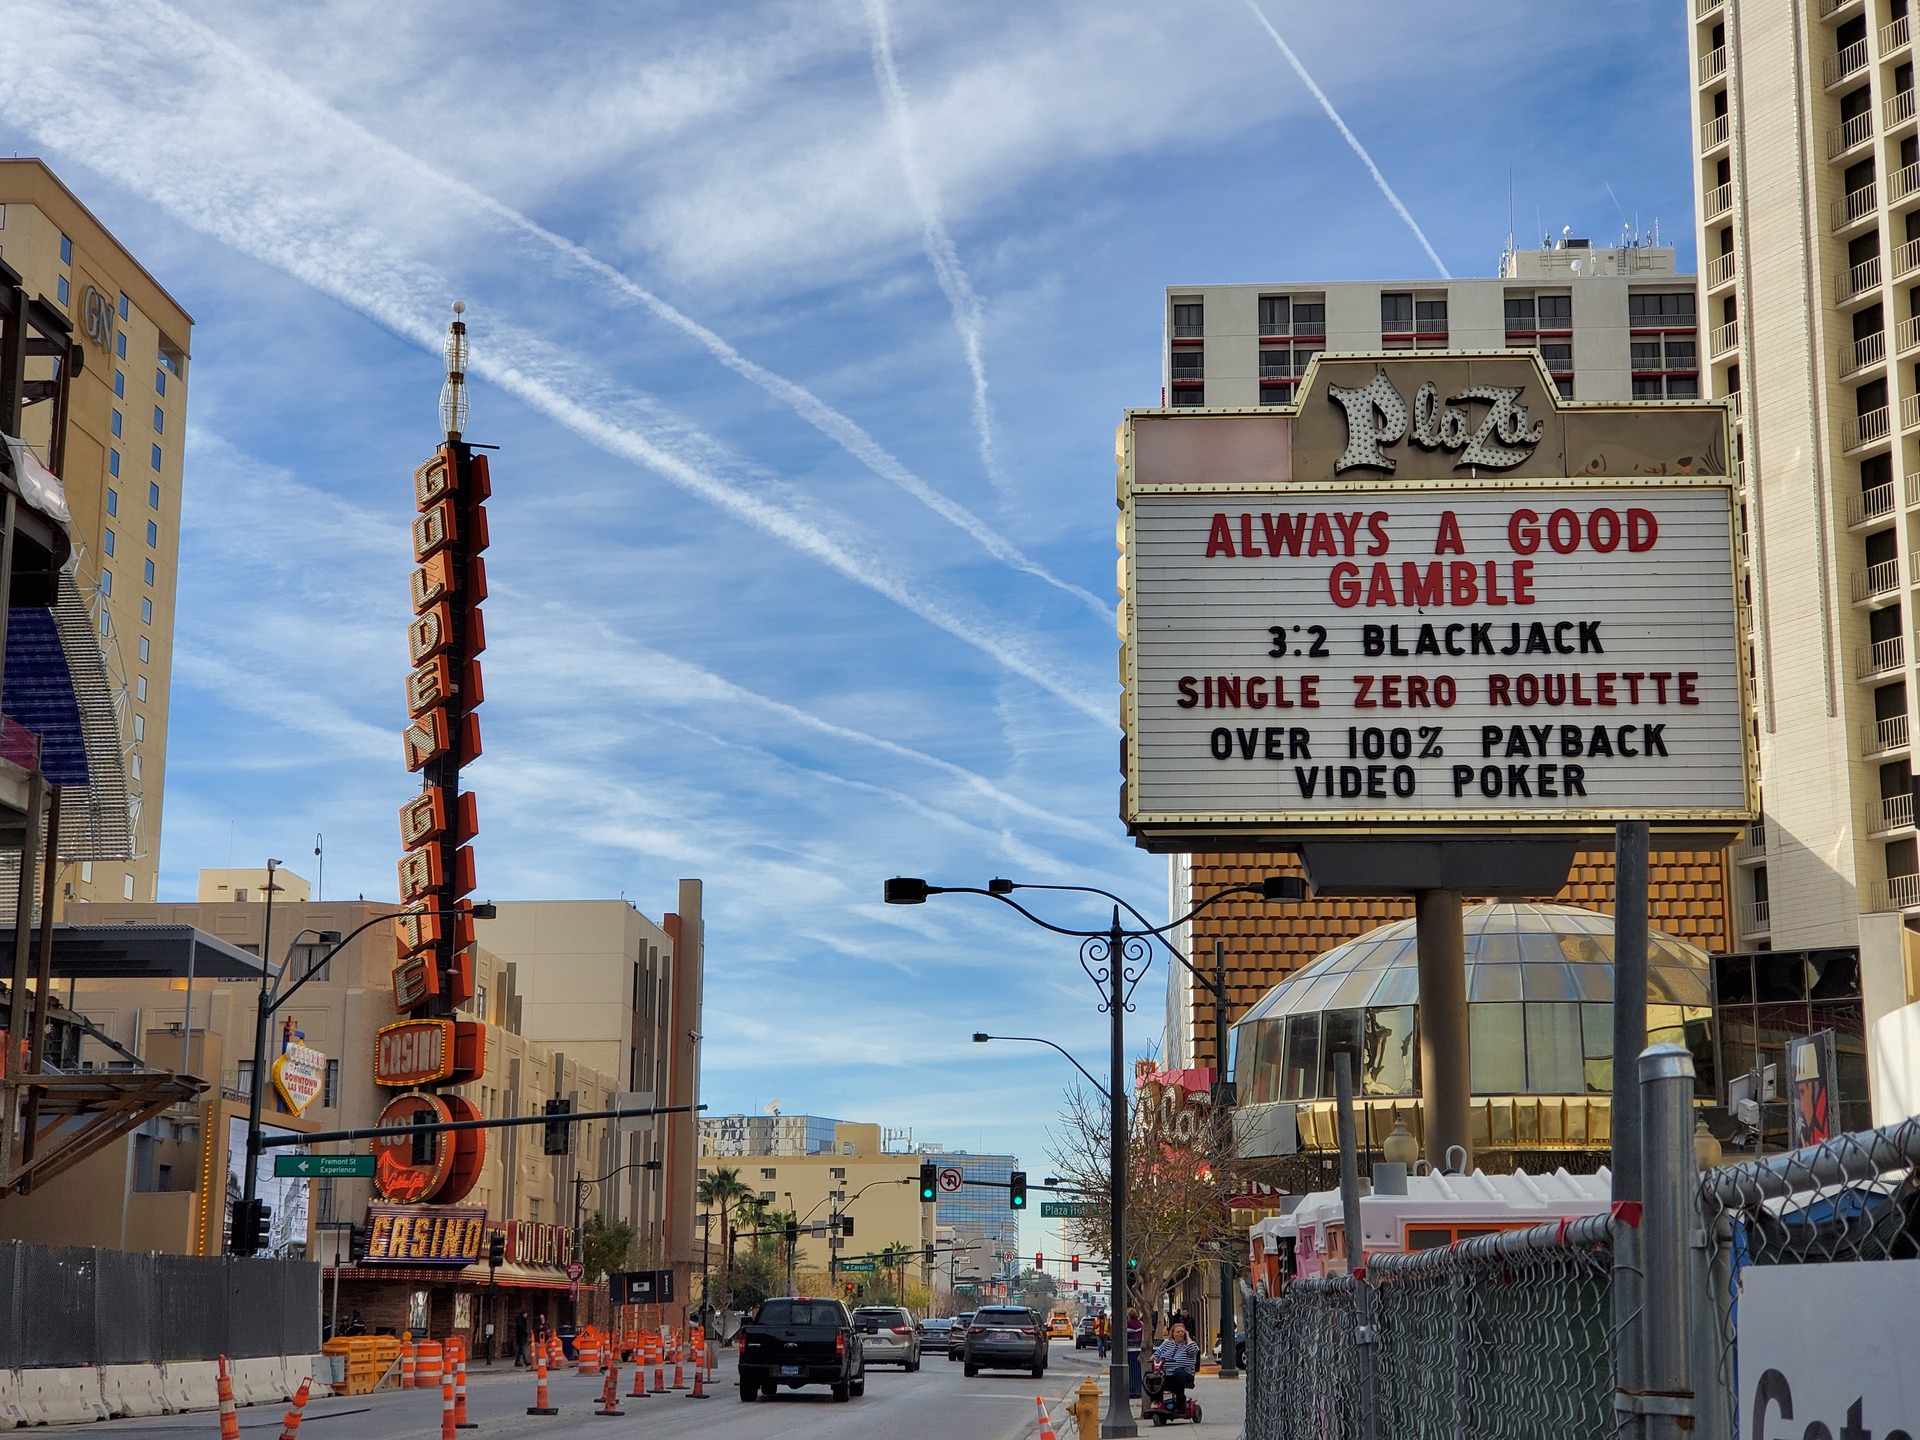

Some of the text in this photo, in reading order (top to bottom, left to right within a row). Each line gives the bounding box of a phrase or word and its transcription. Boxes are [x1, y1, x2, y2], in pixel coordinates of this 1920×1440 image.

[84, 285, 115, 354] GN
[1327, 367, 1544, 475] Plaza
[1205, 508, 1659, 558] ALWAYS A GOOD
[1328, 559, 1536, 609] GAMBLE
[405, 455, 446, 767] GOLDEN
[1267, 620, 1605, 658] 3:2 BLACKJACK
[1177, 671, 1700, 710] SINGLE ZERO ROULETTE
[1210, 723, 1670, 761] OVER 100% PAYBACK
[1294, 763, 1588, 800] VIDEO POKER
[398, 794, 433, 1007] GATE
[379, 1029, 441, 1077] CASINO
[285, 1072, 317, 1088] DOWNTOWN
[288, 1083, 314, 1096] LAS VEGAS
[320, 1166, 357, 1174] Experience
[1045, 1205, 1068, 1215] Plaza
[369, 1215, 484, 1259] CASINO
[515, 1219, 558, 1265] GOLDEN
